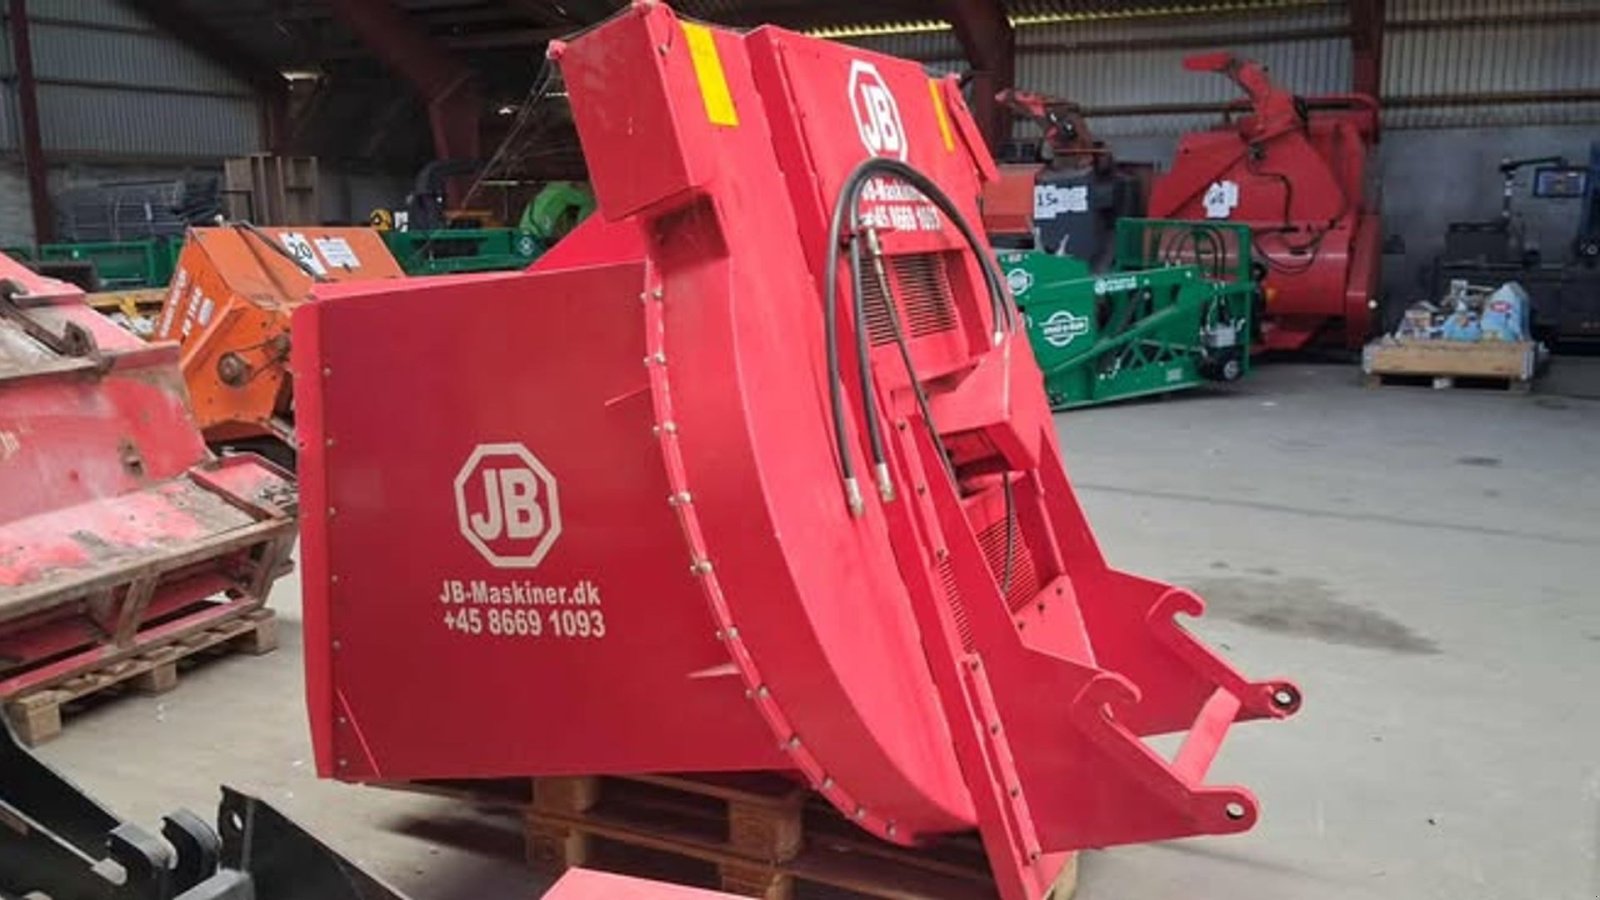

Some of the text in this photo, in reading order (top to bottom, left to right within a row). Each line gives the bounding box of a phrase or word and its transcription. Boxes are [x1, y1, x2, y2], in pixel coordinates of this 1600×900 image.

[861, 84, 899, 151] JB
[471, 469, 543, 540] JB
[440, 580, 600, 604] JB-Maskiner.dk
[444, 609, 606, 638] +45 8669 1093
